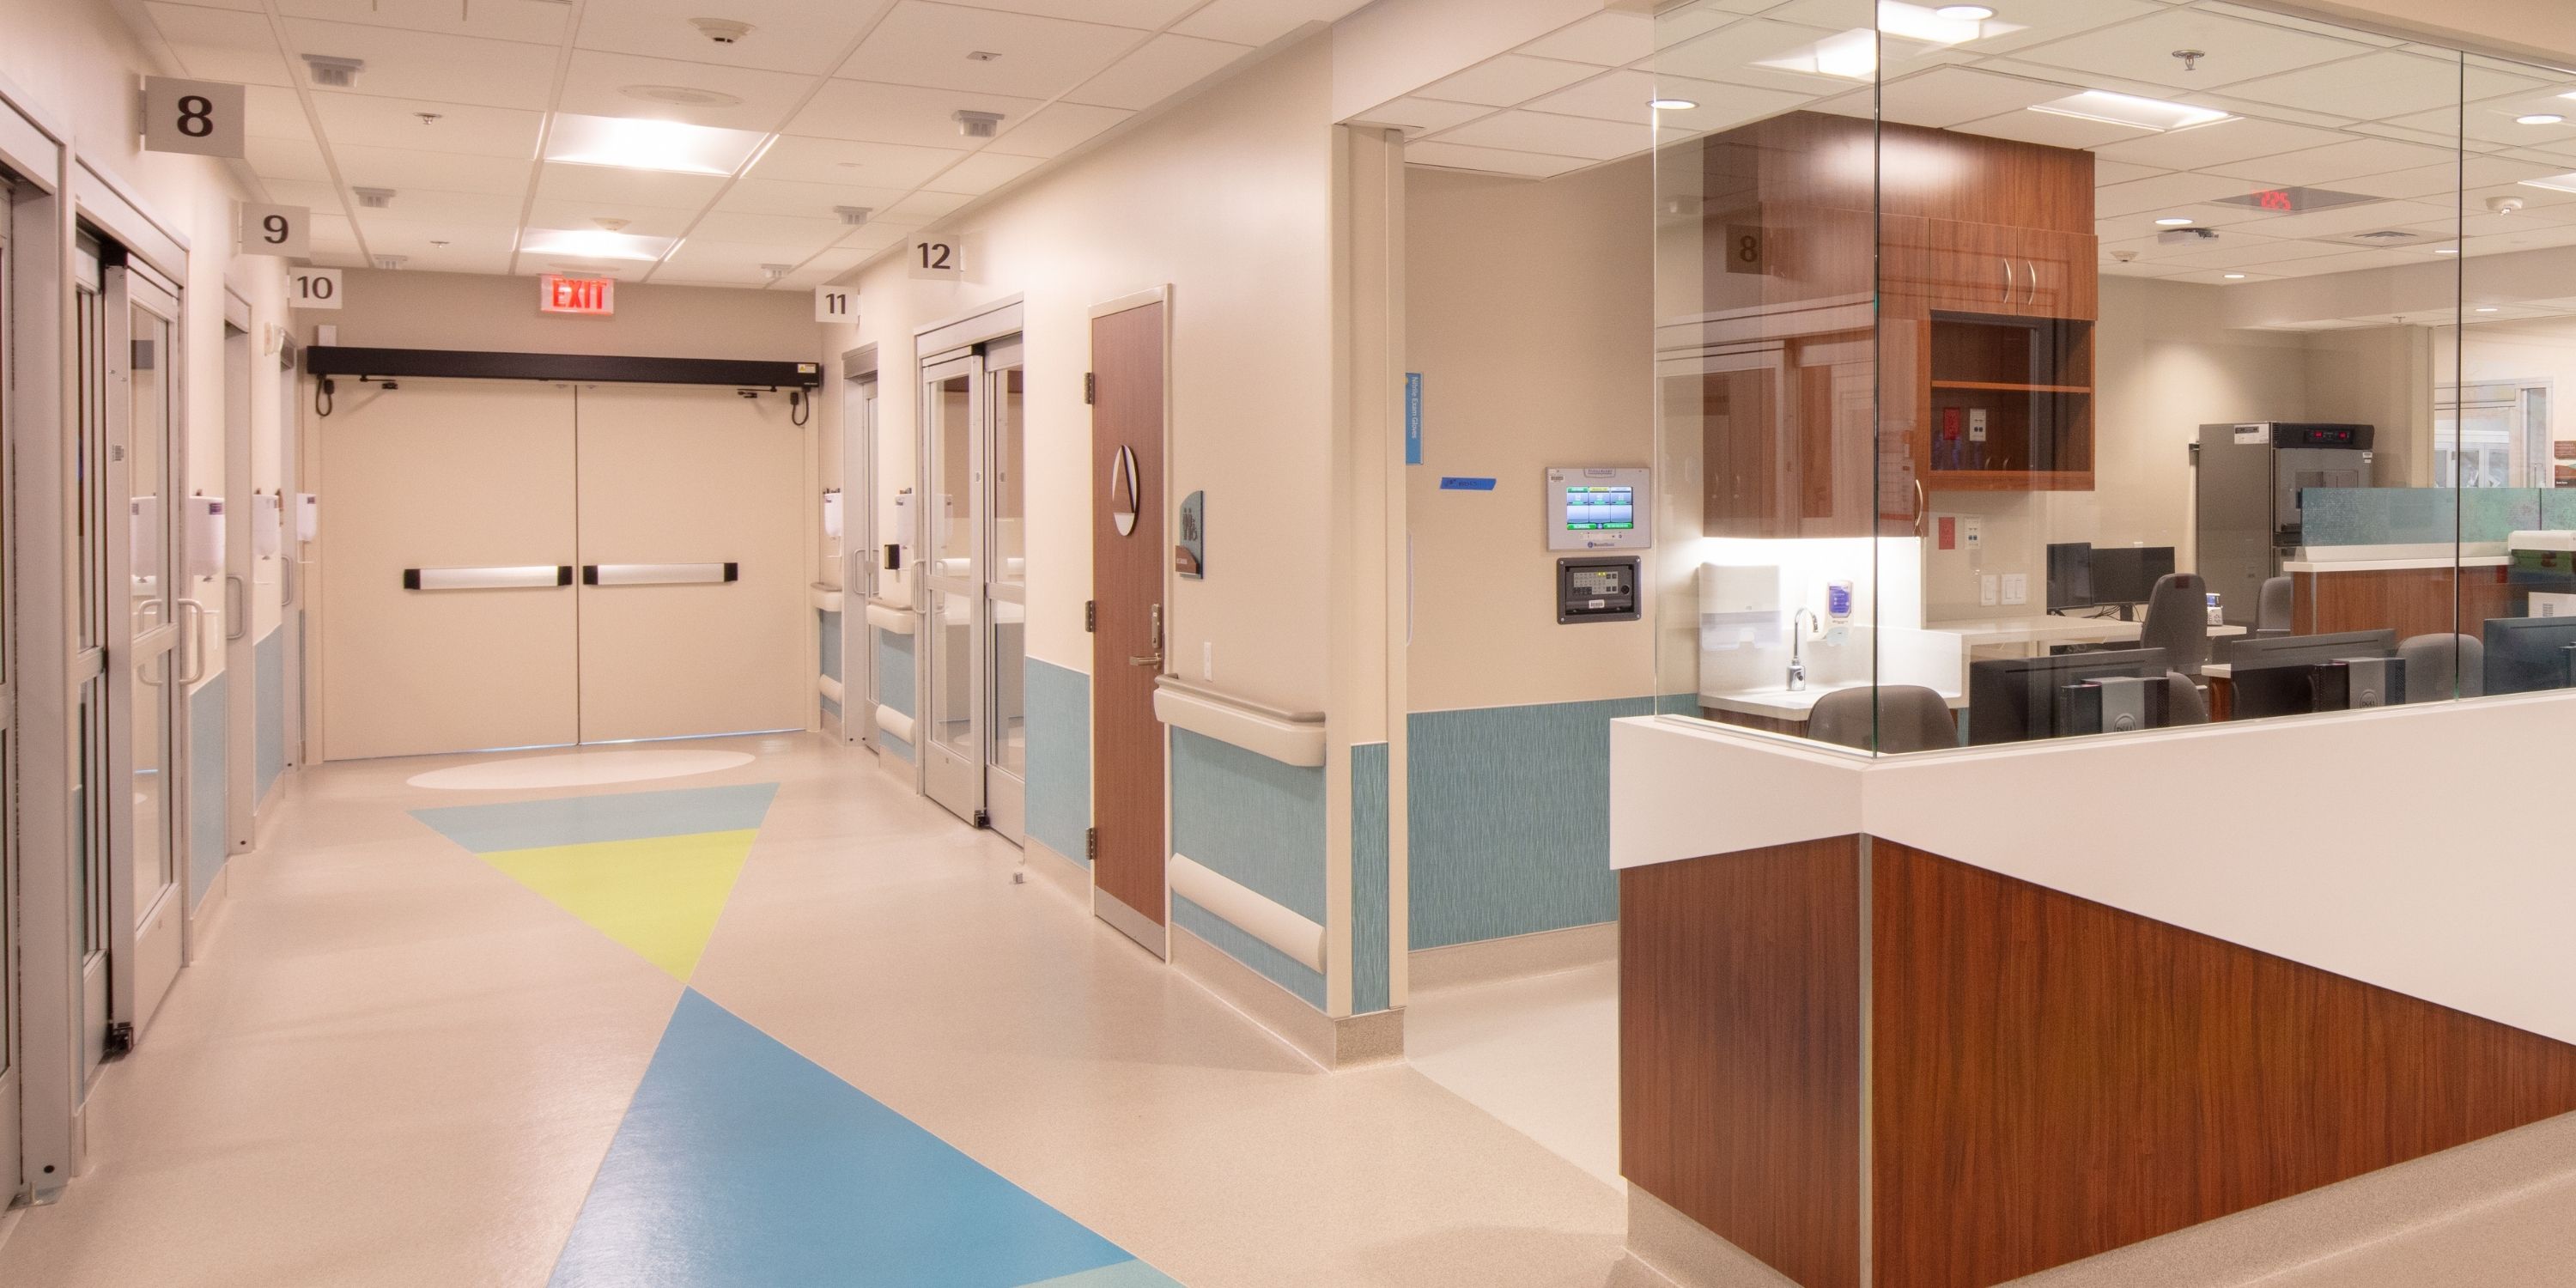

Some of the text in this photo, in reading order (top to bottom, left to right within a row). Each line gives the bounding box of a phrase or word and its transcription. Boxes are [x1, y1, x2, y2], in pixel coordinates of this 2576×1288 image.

[176, 95, 214, 137] 8
[263, 215, 289, 245] 9
[917, 242, 951, 270] 12
[296, 276, 333, 300] 10
[552, 279, 607, 309] EXIT
[825, 293, 846, 314] 11
